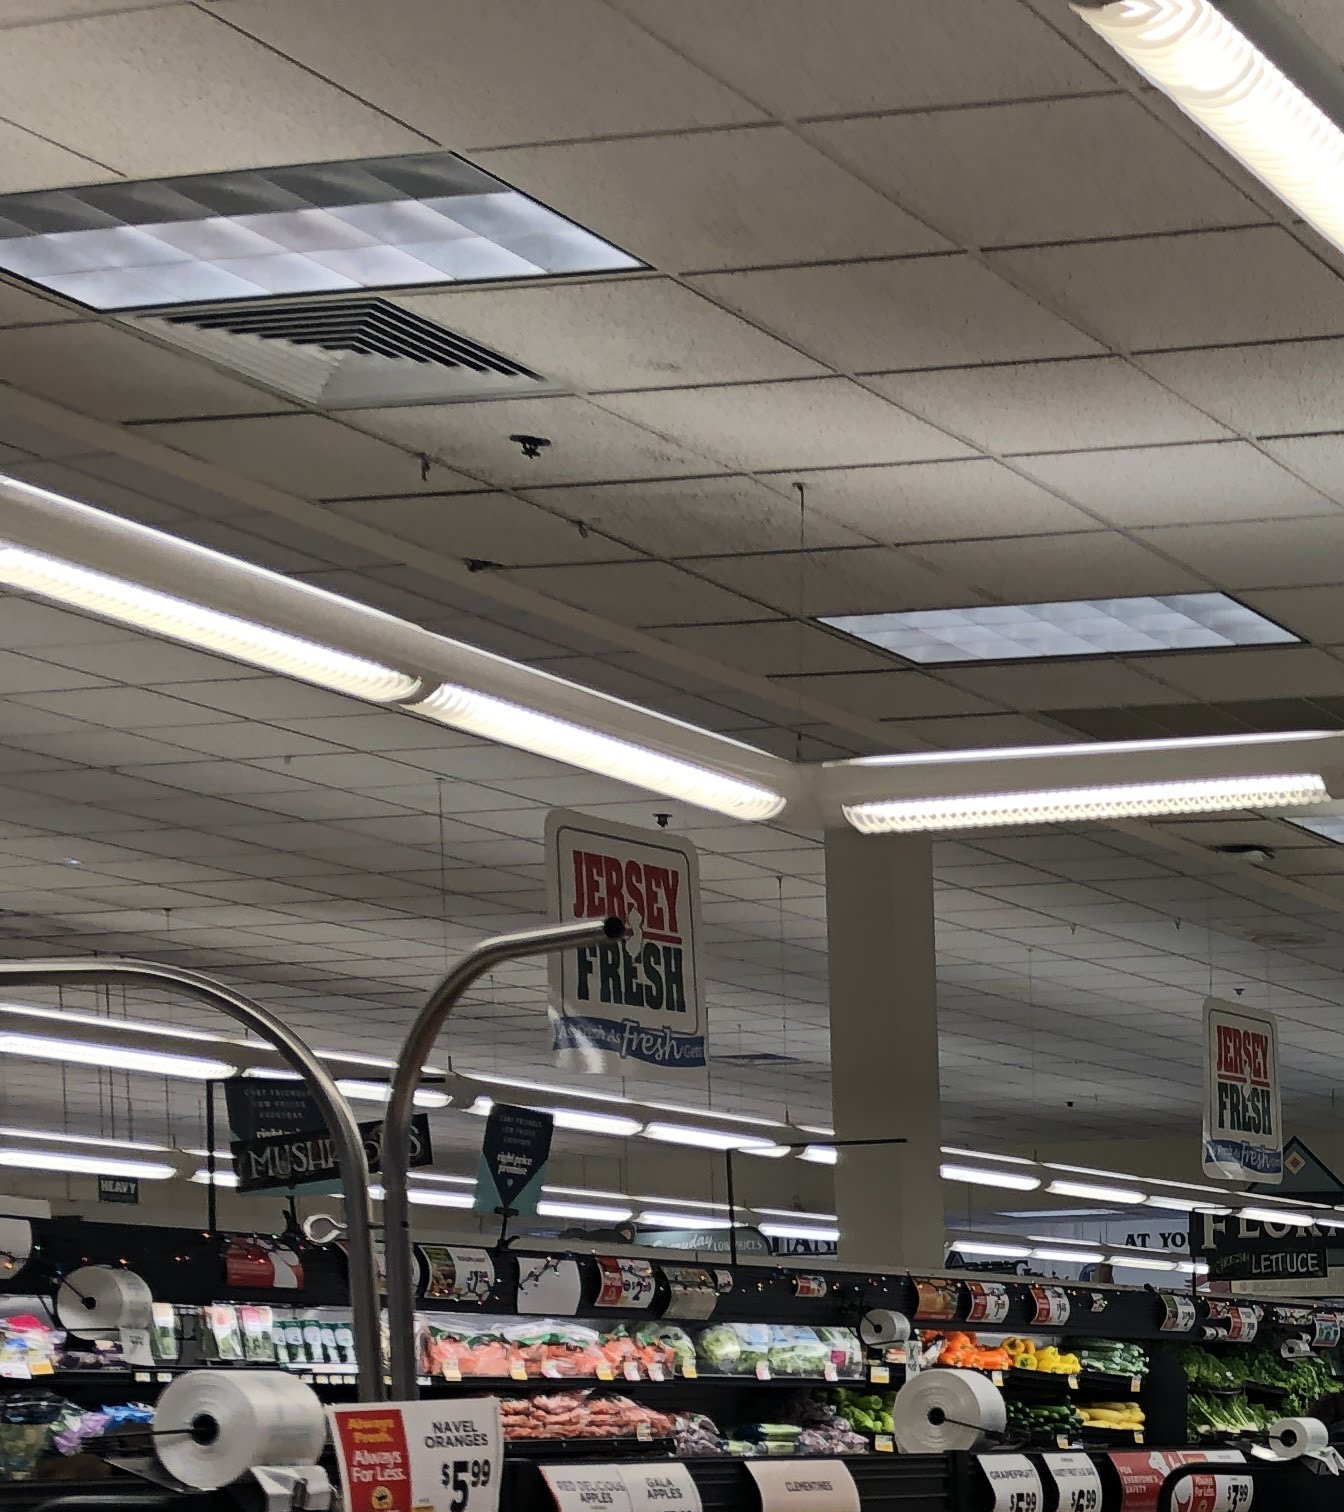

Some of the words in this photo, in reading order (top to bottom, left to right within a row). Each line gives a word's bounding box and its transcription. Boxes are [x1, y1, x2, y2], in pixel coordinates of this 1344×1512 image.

[572, 849, 680, 934] JERSEY
[577, 941, 687, 1013] FRESH
[620, 1017, 683, 1060] Fresh
[1216, 1024, 1269, 1080] JERSEY
[1218, 1082, 1272, 1136] FRESH
[249, 1125, 421, 1180] MUSHOS
[100, 1179, 136, 1194] HEAVY
[1125, 1232, 1151, 1248] AT
[1252, 1252, 1320, 1275] LETTUCE
[432, 1420, 479, 1433] NAVEL
[424, 1433, 489, 1449] ORANGES
[352, 1450, 402, 1467] Always
[352, 1467, 375, 1483] For
[989, 1468, 1034, 1480] GRAPEFRUIT
[645, 1477, 673, 1488] GALA
[580, 1491, 613, 1504] APPLES
[646, 1487, 683, 1500] APPLES
